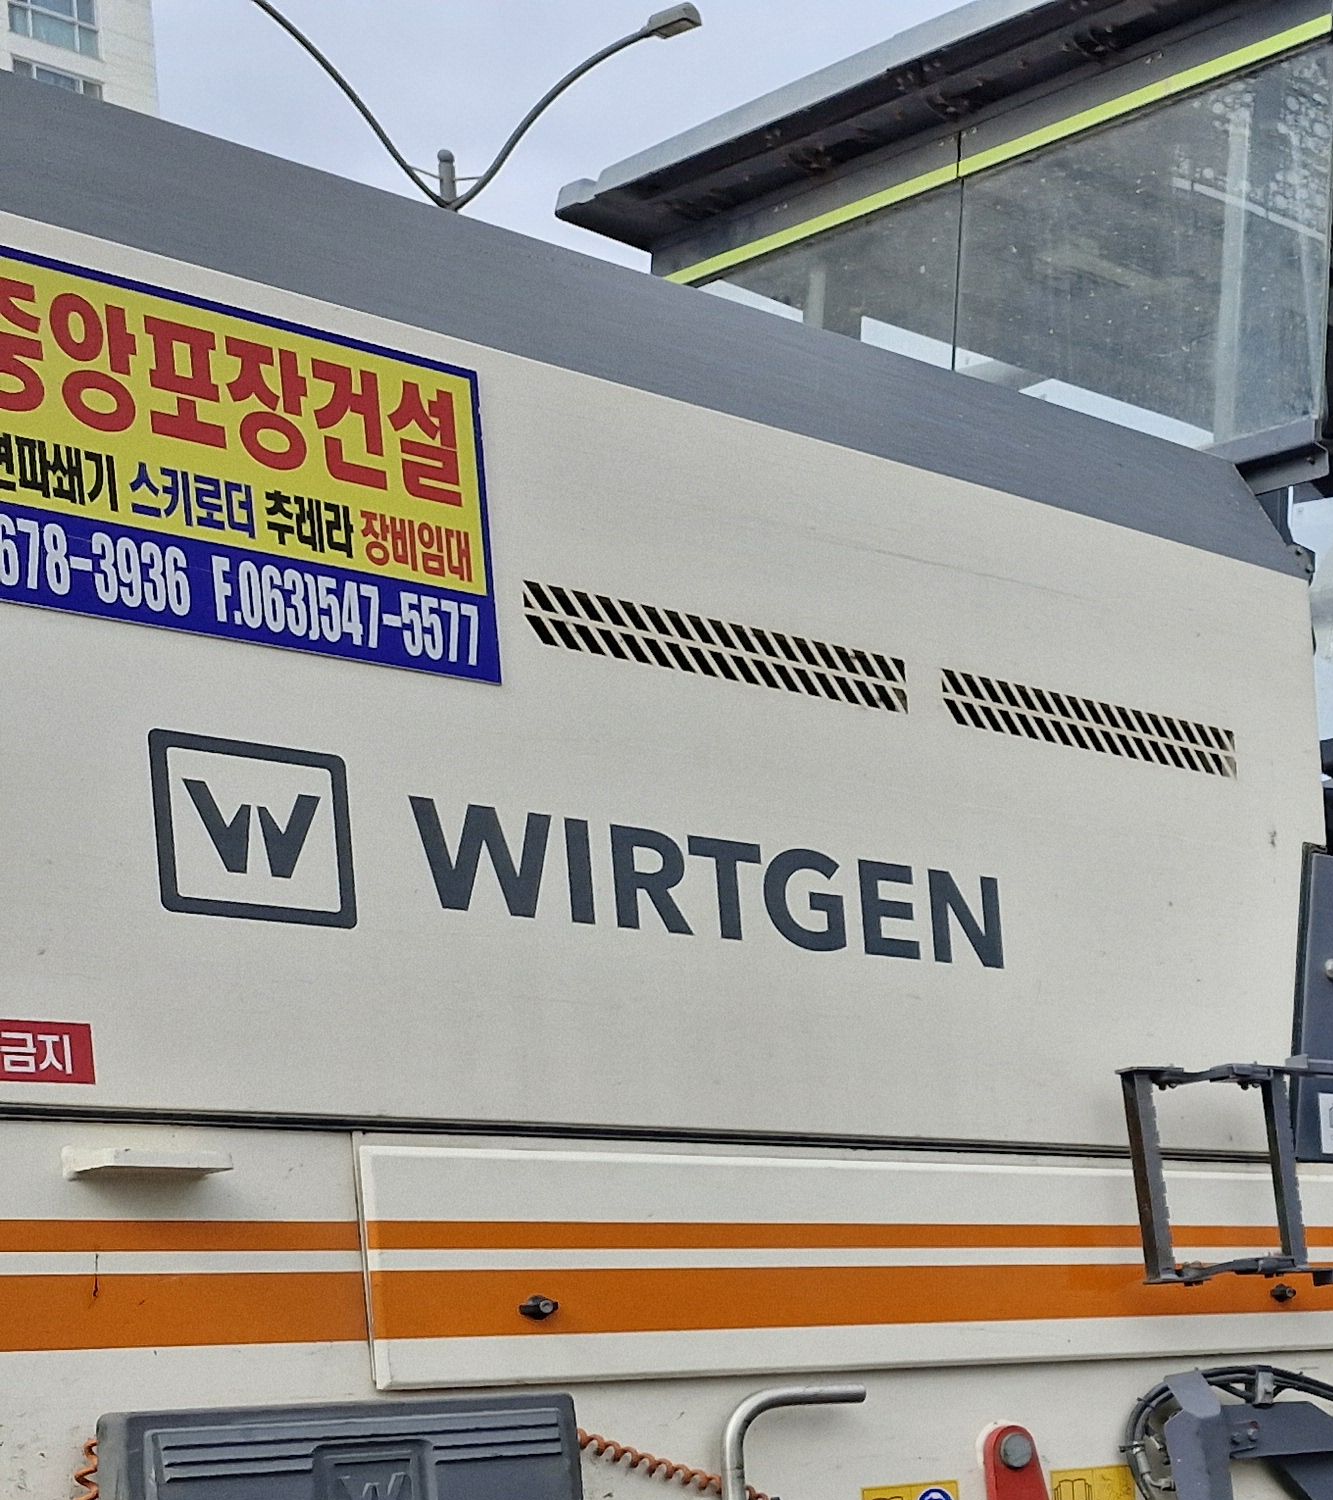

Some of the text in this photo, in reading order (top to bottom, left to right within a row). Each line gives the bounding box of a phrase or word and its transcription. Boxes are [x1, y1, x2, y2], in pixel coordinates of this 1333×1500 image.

[0, 514, 479, 666] 678-3936 F.063)547-5577
[130, 461, 256, 538] 스키로더
[265, 490, 354, 558] 추레라
[360, 510, 473, 583] 장비임대
[408, 795, 1005, 970] WIRTGEN
[0, 1031, 73, 1075] 금지
